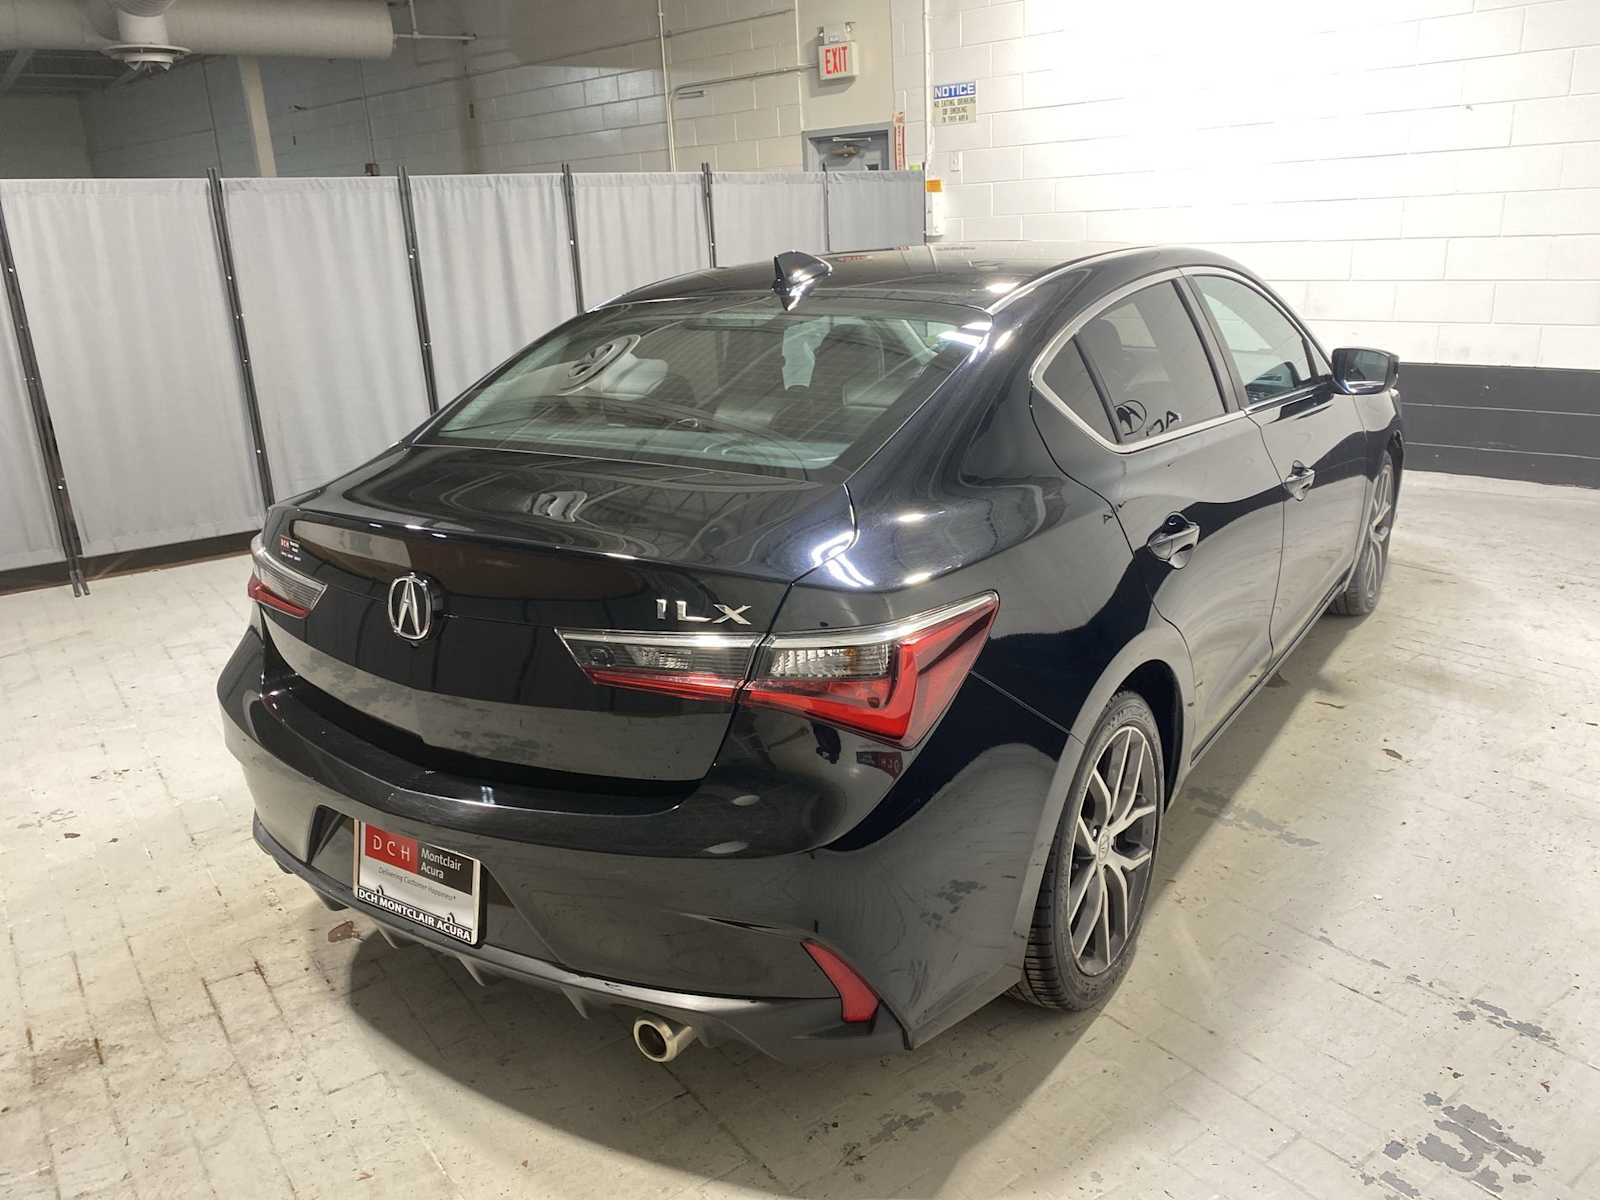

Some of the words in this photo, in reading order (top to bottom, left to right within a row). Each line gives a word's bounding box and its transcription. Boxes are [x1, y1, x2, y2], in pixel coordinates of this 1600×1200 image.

[825, 46, 848, 75] EXIT
[934, 83, 976, 98] NOTICE
[656, 599, 752, 625] ILX
[421, 847, 462, 871] Montclair
[421, 862, 444, 879] Acura
[359, 888, 378, 904] DCH
[379, 897, 435, 926] MONTCLAIR
[436, 920, 471, 941] ACURA
